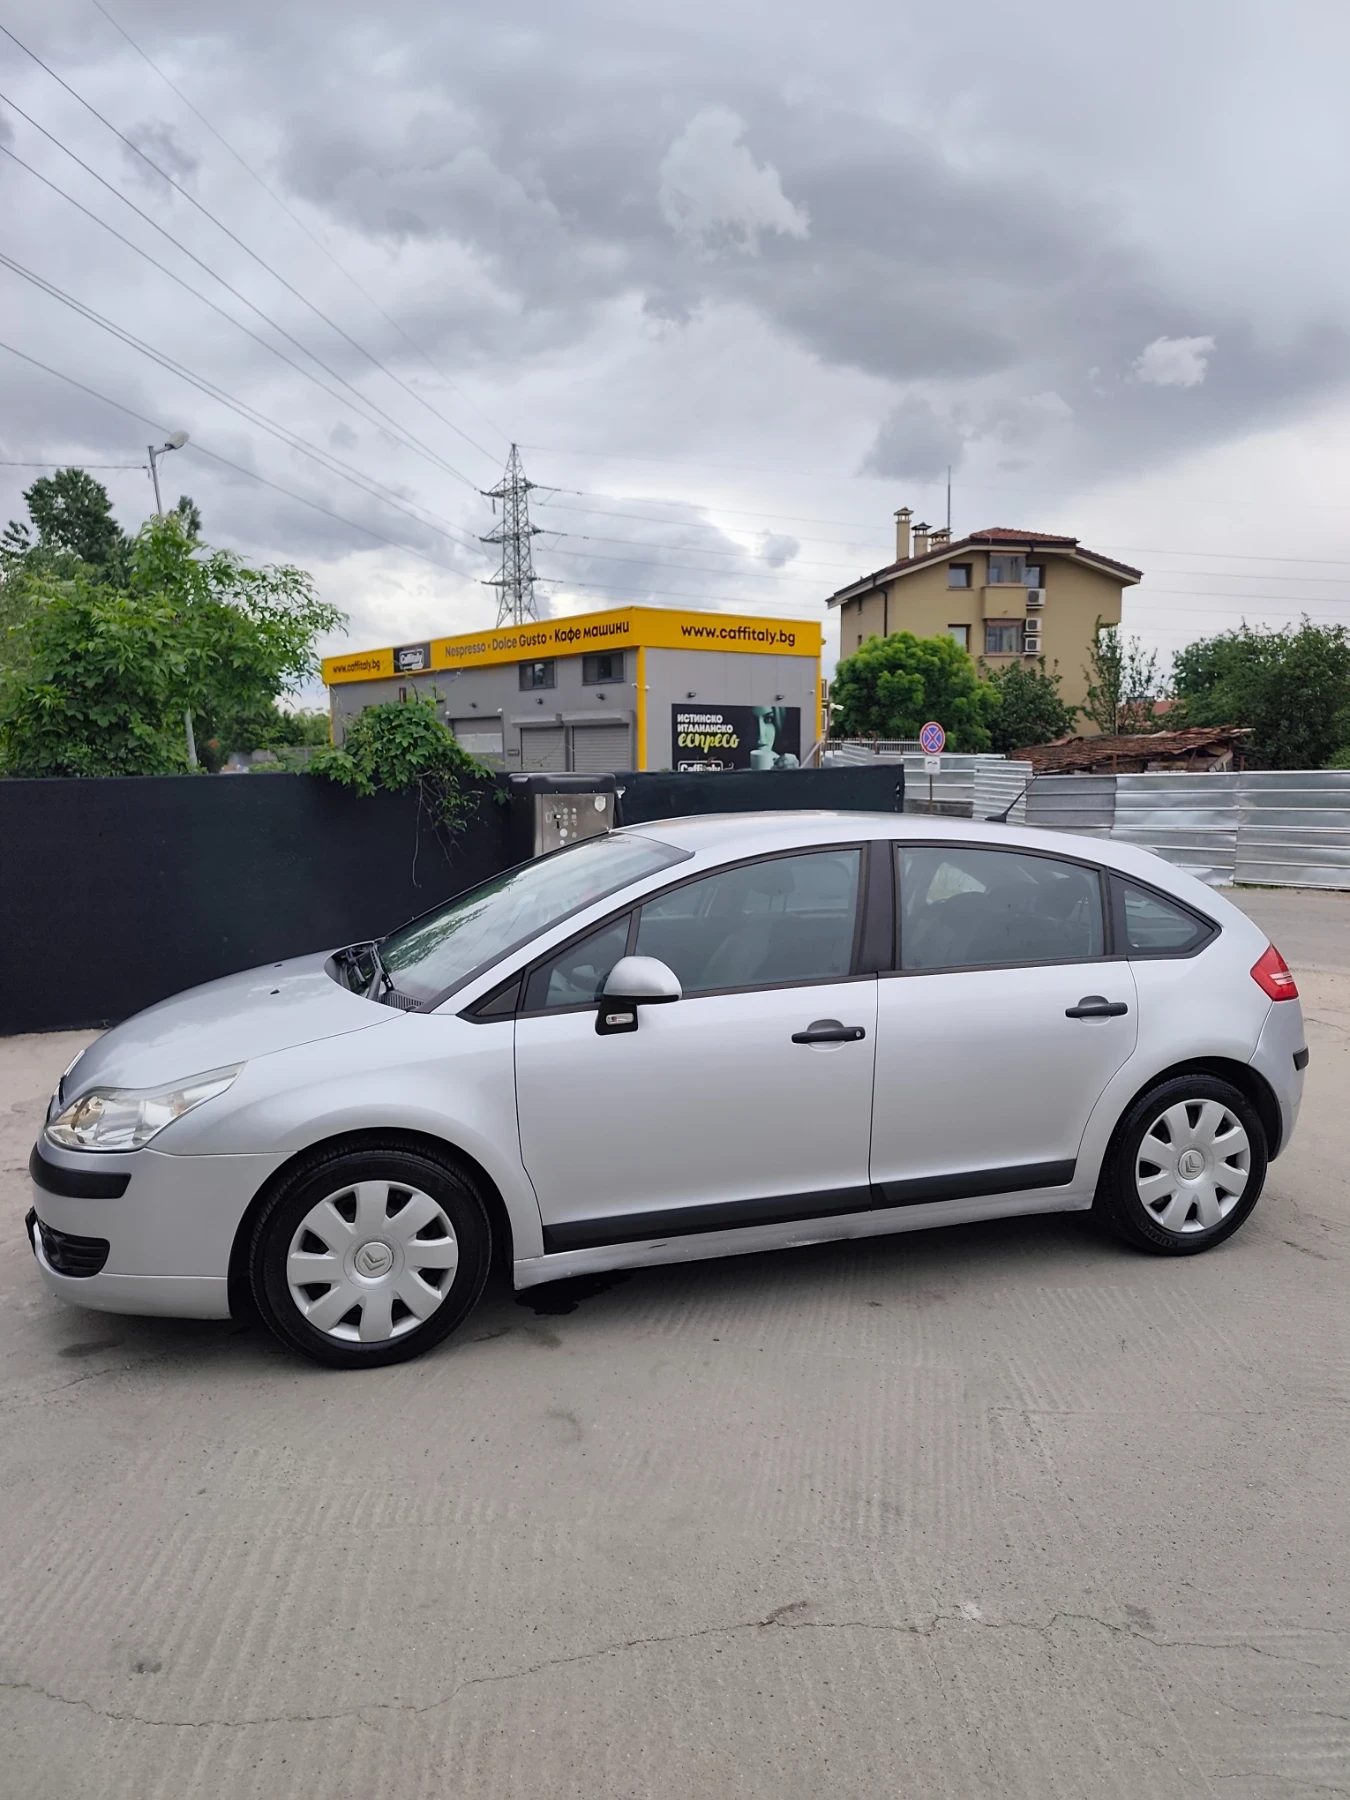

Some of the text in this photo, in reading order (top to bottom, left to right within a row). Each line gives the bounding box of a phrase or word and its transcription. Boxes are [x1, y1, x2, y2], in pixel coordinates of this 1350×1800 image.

[445, 621, 630, 659] Nespresso Dolce Gusto Кафе машини
[680, 625, 796, 647] www.caffitaly.bg
[333, 659, 381, 674] www.caffitaly.bg
[677, 714, 723, 724] ИСТИНСКО
[677, 724, 734, 733] ИТАЛИАНСКО
[678, 733, 740, 754] еспресо
